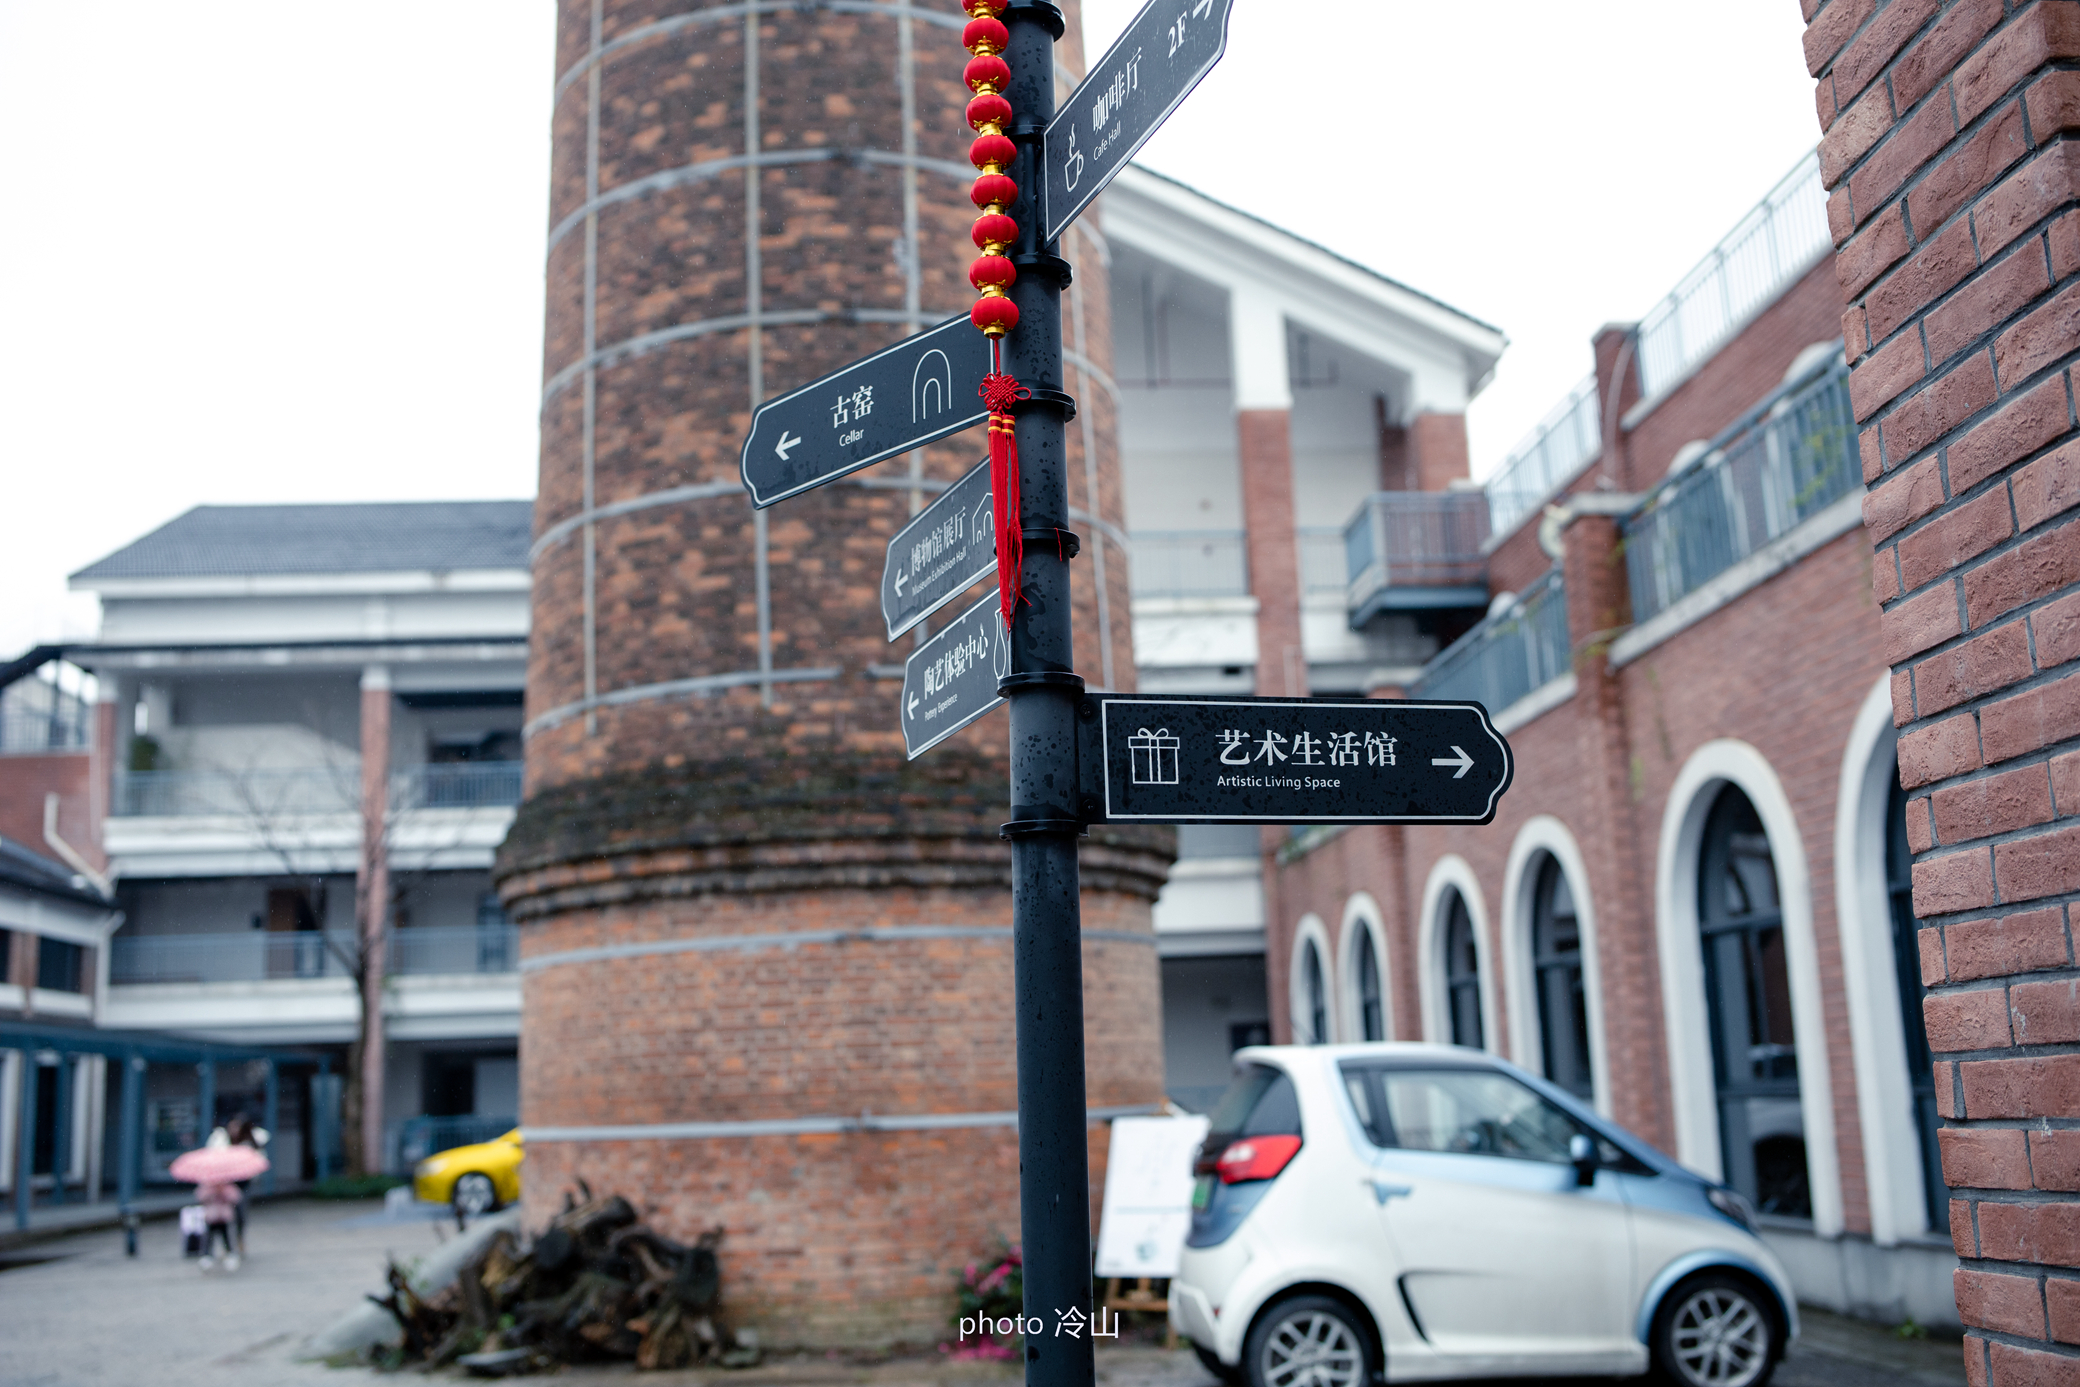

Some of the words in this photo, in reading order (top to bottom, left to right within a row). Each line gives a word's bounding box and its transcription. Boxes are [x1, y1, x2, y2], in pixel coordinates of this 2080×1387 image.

[1093, 47, 1142, 135] 咖啡厅
[1168, 11, 1188, 59] 2F
[1093, 138, 1109, 161] Cafe
[1108, 120, 1121, 143] Hall
[830, 385, 874, 429] 古窑
[839, 427, 865, 447] Cellar
[911, 506, 966, 577] 博物馆展厅
[912, 576, 932, 597] Museum
[931, 556, 957, 582] Exhibition
[956, 546, 967, 563] Hall
[924, 623, 989, 700] 陶艺体验中心
[924, 706, 938, 722] Pottery
[937, 693, 958, 713] Experience
[1215, 729, 1398, 766] 艺术生活馆
[1217, 775, 1262, 787] Artistic
[1264, 775, 1301, 790] Living
[1304, 776, 1341, 790] Space
